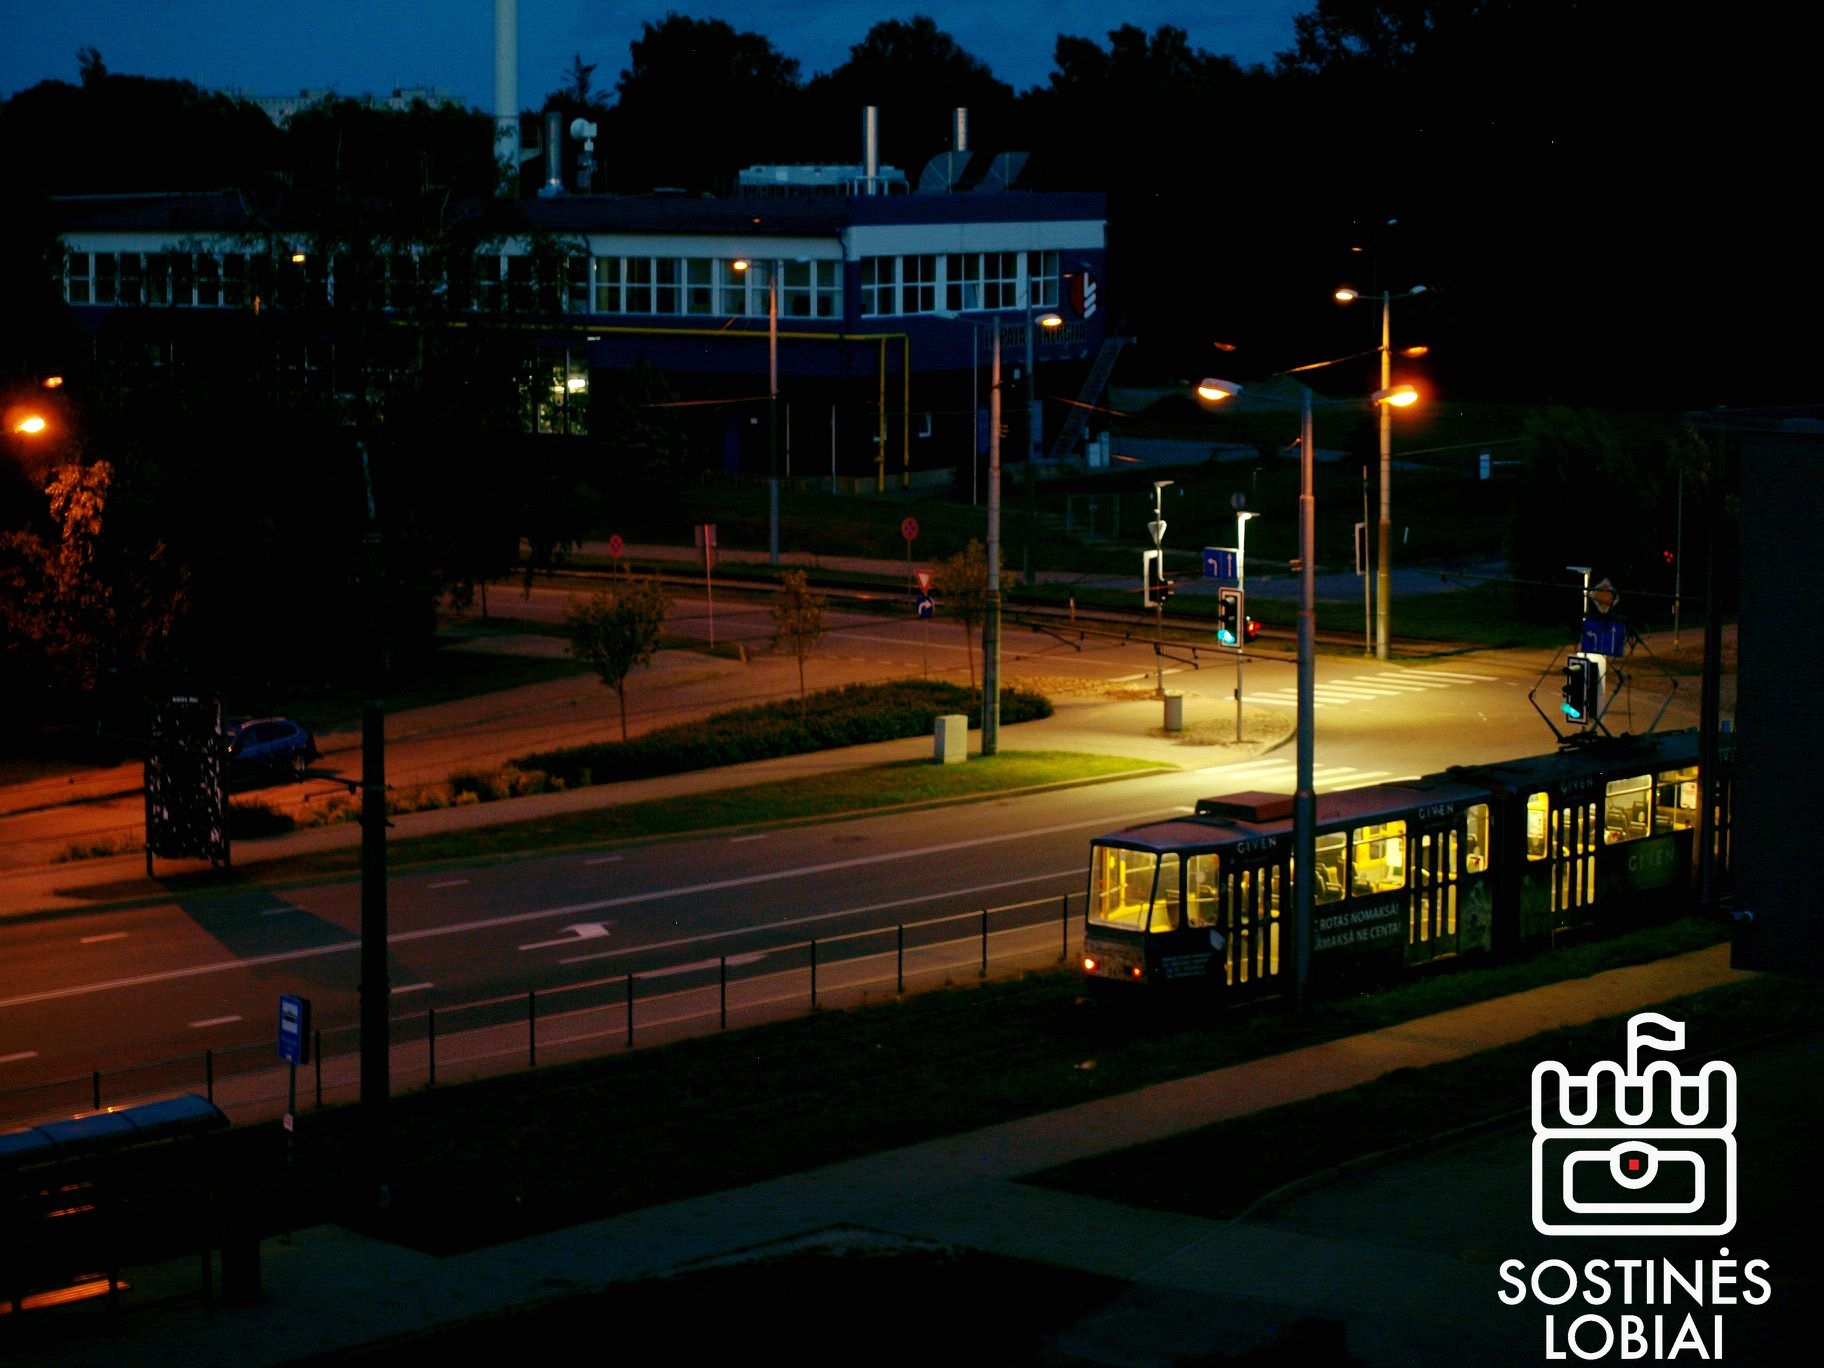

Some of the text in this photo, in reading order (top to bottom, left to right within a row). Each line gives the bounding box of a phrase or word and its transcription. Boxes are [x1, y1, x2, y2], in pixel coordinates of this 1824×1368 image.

[1560, 777, 1593, 795] GIVEN
[1418, 803, 1454, 820] GIVEN
[1236, 837, 1277, 854] GIVEN
[1628, 848, 1675, 872] GIVEN
[1320, 914, 1349, 930] ROTAS
[1355, 926, 1370, 942] NE
